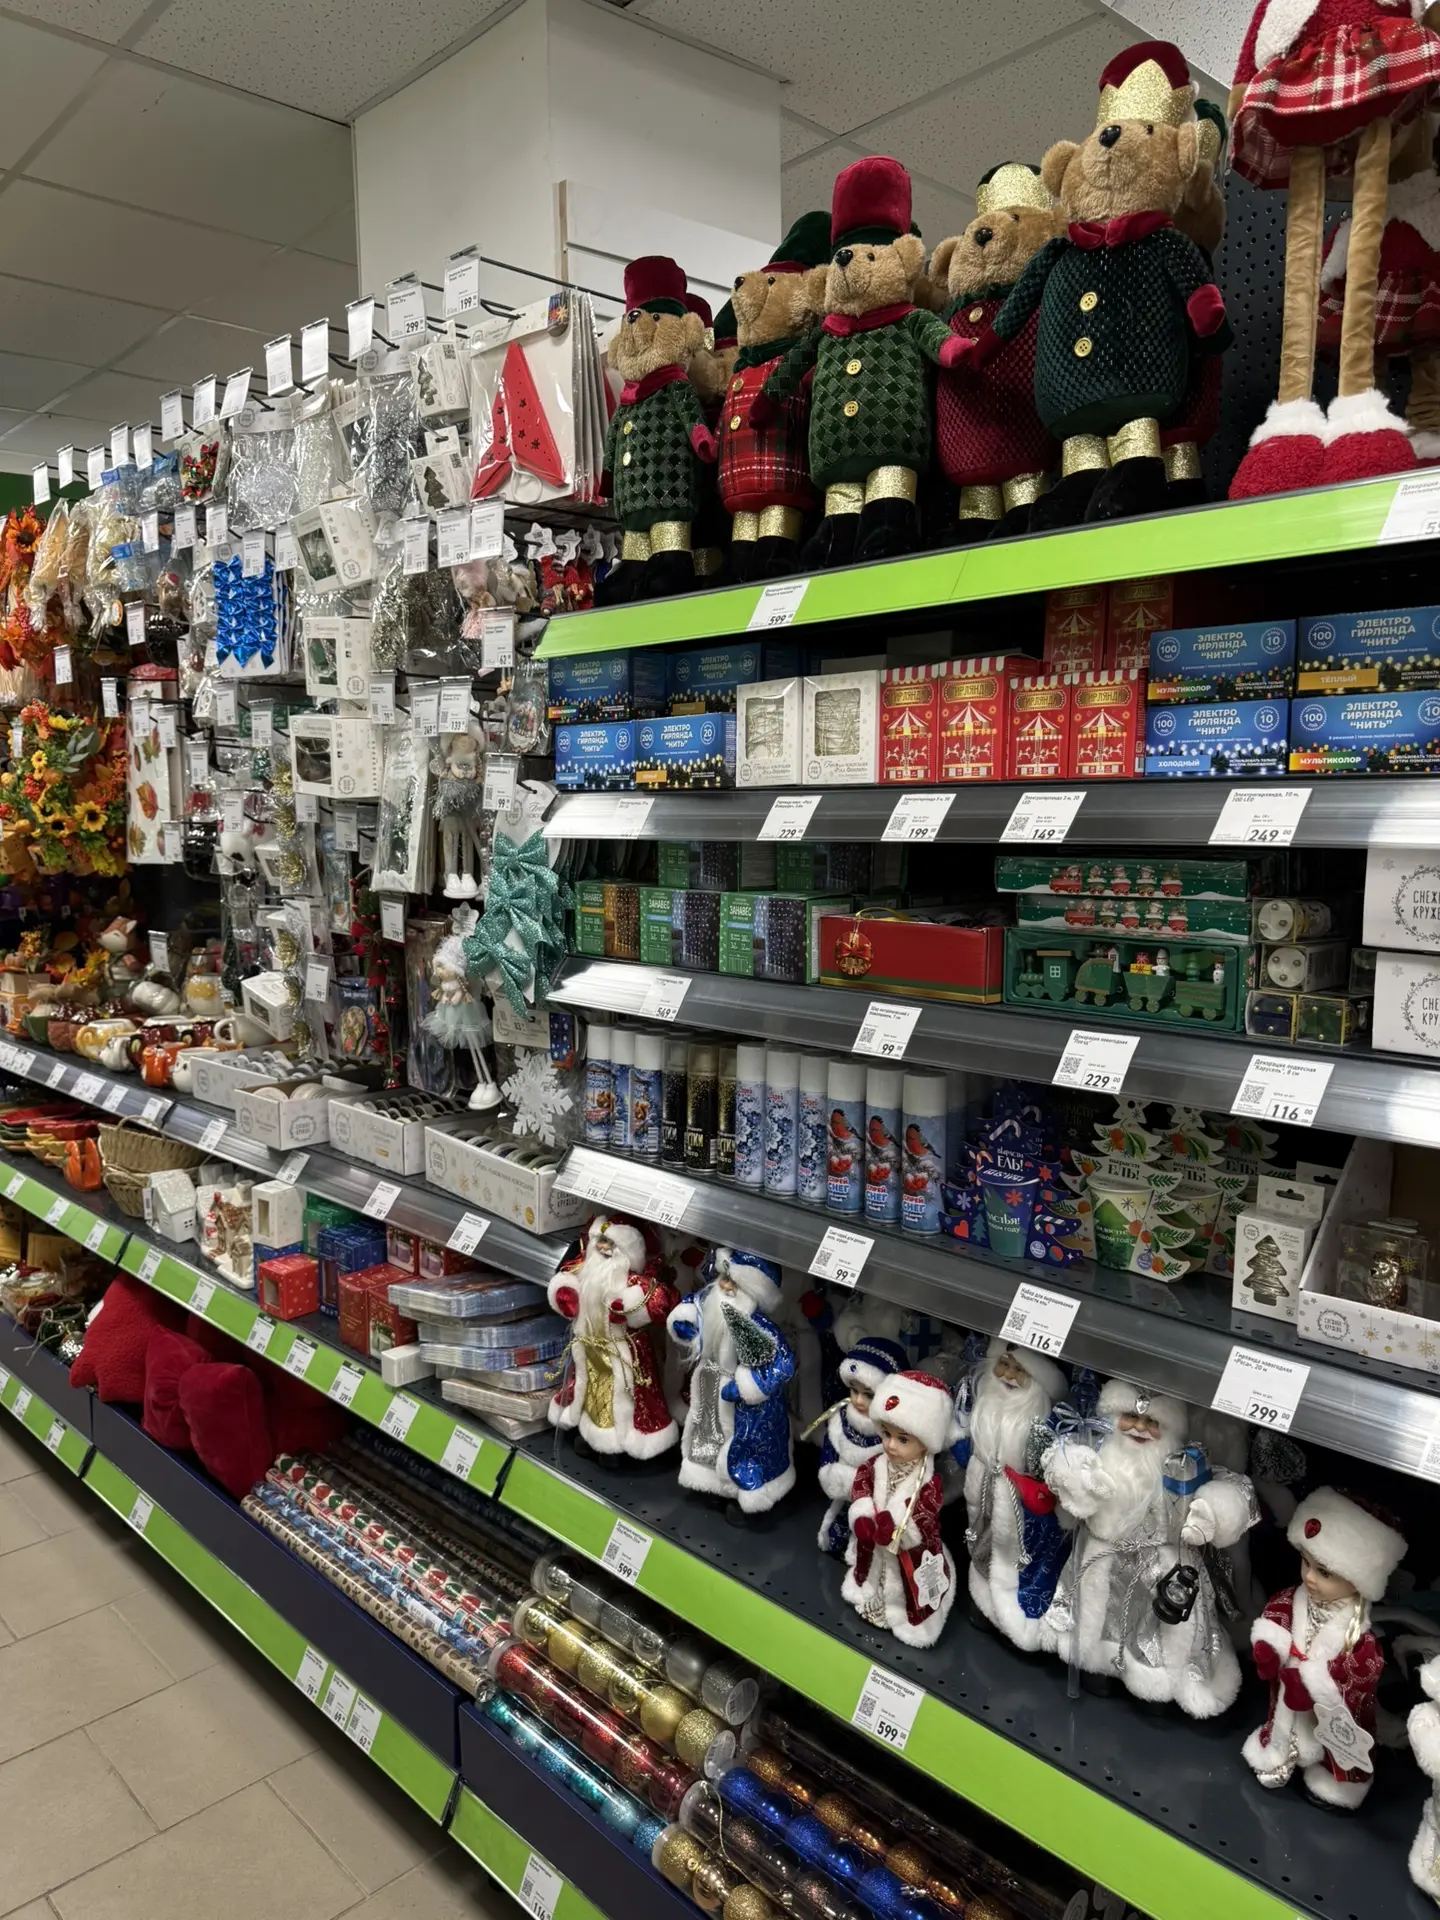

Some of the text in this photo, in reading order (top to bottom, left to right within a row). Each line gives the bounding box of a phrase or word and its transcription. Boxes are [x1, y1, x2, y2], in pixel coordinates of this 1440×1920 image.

[768, 615, 787, 626] 599
[1357, 616, 1411, 628] ЭЛЕКТРО
[1197, 632, 1244, 642] ЭЛЕКТРО
[1312, 631, 1331, 640] 100
[1351, 626, 1416, 638] ГИРЛЯНДА
[1193, 641, 1247, 651] ГИРЛЯНДА
[1267, 637, 1281, 646] 10
[1161, 645, 1177, 654] 100
[700, 654, 729, 664] ЭЛЕКТРО
[743, 659, 752, 667] 20
[574, 661, 600, 669] ЭЛЕКТРО
[698, 661, 732, 671] ГИРЛЯНДА
[553, 671, 565, 680] 200
[572, 668, 603, 677] ГИРЛЯНДА
[1156, 685, 1212, 694] МУЛЬТИКОЛОР
[1346, 701, 1398, 710] ЭЛЕКТРО
[1192, 709, 1237, 718] ЭЛЕКТРО
[1341, 710, 1403, 720] ГИРЛЯНДА
[1425, 707, 1440, 716] 10
[1188, 717, 1241, 727] ГИРЛЯНДА
[1260, 715, 1274, 724] 10
[1304, 713, 1323, 722] 100
[663, 724, 691, 733] ЭЛЕКТРО
[1157, 720, 1173, 728] 100
[580, 730, 606, 738] ЭЛЕКТРО
[641, 733, 652, 742] 200
[660, 731, 693, 741] ГИРЛЯНДА
[703, 729, 712, 737] 20
[558, 738, 570, 746] 200
[577, 737, 608, 745] ГИРЛЯНДА
[619, 735, 627, 743] 20
[1158, 758, 1200, 768] ХОЛОДНЫЙ
[1300, 757, 1361, 765] МУЛЬТИКОЛОР
[779, 829, 796, 839] 229
[908, 828, 928, 838] 199
[1032, 829, 1055, 840] 149
[1248, 829, 1279, 841] 249
[648, 898, 670, 910] ЗАНАВЕС
[729, 905, 751, 917] ЗАНАВЕС
[656, 1007, 669, 1018] 549
[1073, 1033, 1128, 1045] Декорация новогодняя
[881, 1043, 895, 1055] 99
[1255, 1059, 1316, 1073] Декорация подвесная
[1084, 1073, 1110, 1088] 229
[1272, 1104, 1299, 1120] 116
[997, 1155, 1024, 1172] ЕЛЬ!
[1109, 1158, 1140, 1168] вырасти
[1108, 1164, 1140, 1181] ЕЛЬ!
[829, 1176, 849, 1185] СПРЕЙ
[828, 1184, 850, 1194] СНЕГ
[866, 1185, 886, 1193] СПРЕЙ
[866, 1192, 888, 1201] СНЕГ
[903, 1195, 924, 1204] СПРЕЙ
[903, 1202, 926, 1212] СНЕГ
[461, 1243, 470, 1254] 69
[836, 1268, 848, 1280] 99
[1021, 1287, 1034, 1297] Набор
[1044, 1296, 1074, 1309] выращивания
[1029, 1333, 1051, 1350] 116
[1233, 1358, 1254, 1369] «Роса»,
[1235, 1351, 1293, 1374] Гирлянда новогодняя
[1249, 1403, 1278, 1423] 299
[391, 1425, 402, 1438] 116
[456, 1463, 464, 1474] 99
[617, 1562, 633, 1578] 599
[870, 1676, 881, 1685] «Дед
[872, 1669, 916, 1696] Декорация новогодняя
[877, 1720, 898, 1741] 599
[360, 1735, 367, 1747] 62
[534, 1902, 545, 1920] 116
